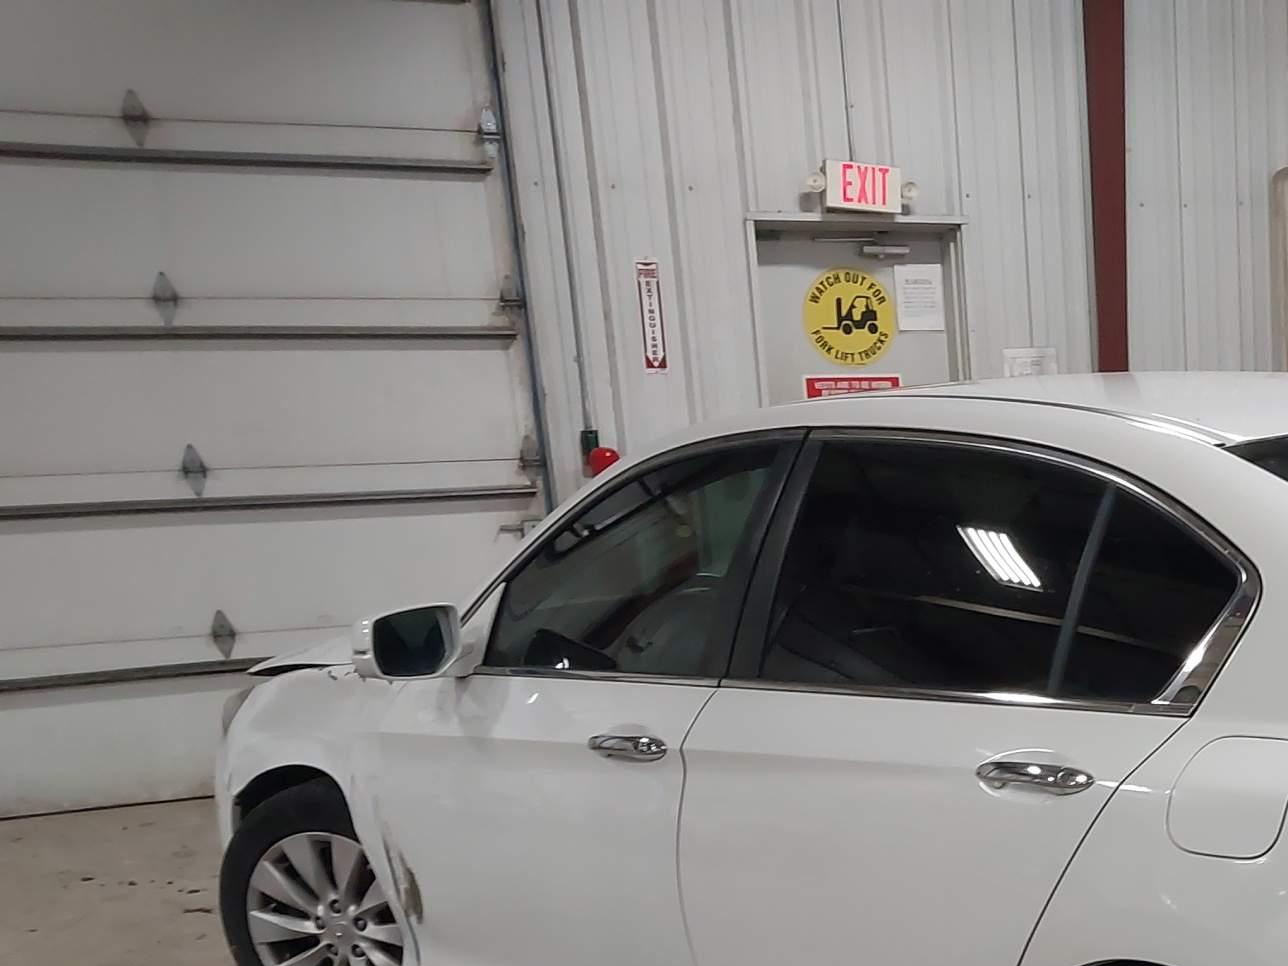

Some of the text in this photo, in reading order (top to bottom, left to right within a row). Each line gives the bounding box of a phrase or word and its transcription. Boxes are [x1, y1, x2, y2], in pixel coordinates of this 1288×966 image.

[842, 163, 890, 206] EXIT
[808, 273, 841, 304] WATCH
[844, 272, 867, 287] OUT
[866, 282, 887, 305] FOR
[645, 280, 659, 362] EXTINGUISHER
[811, 329, 889, 363] FORK LIFT TRUCKS
